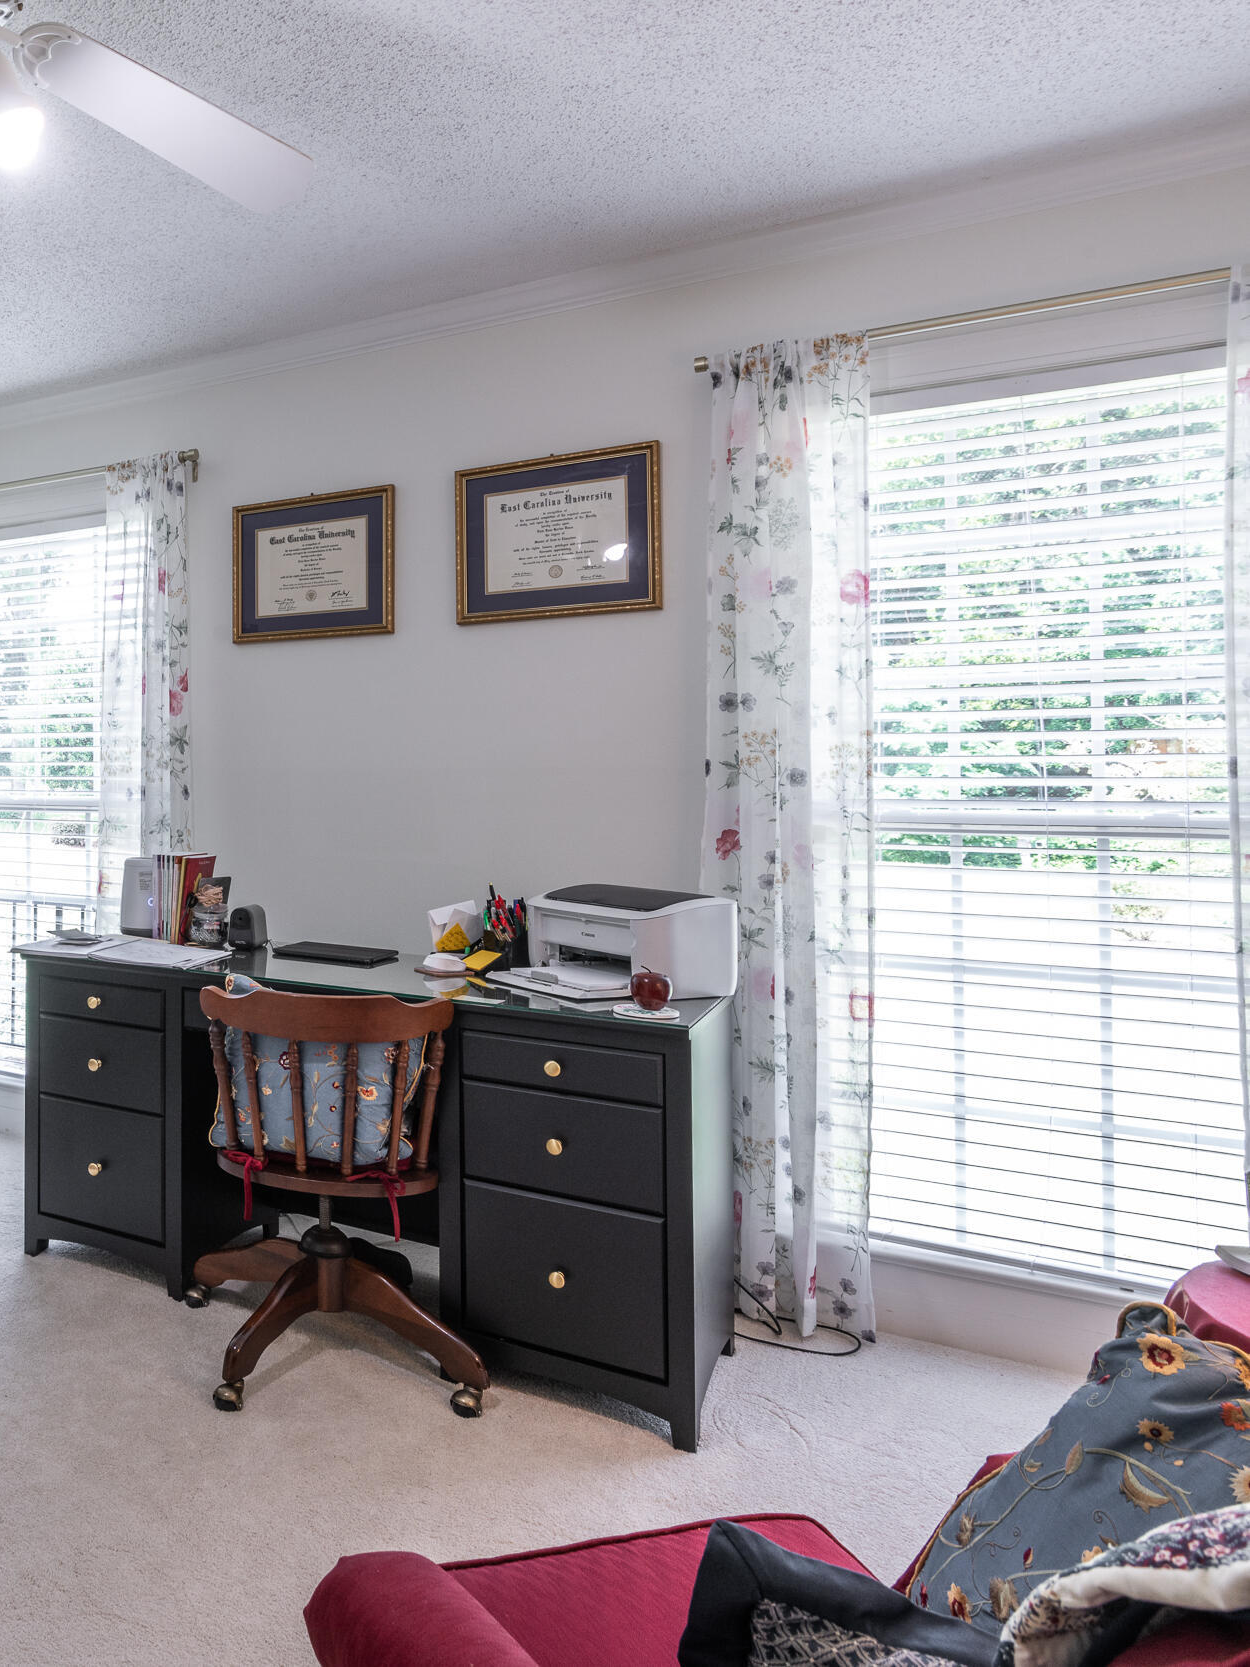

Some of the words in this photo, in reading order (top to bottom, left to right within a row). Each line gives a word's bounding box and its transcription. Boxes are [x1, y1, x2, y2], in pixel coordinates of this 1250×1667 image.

[500, 503, 520, 514] East
[523, 498, 561, 510] Carolina
[564, 491, 612, 504] University
[269, 536, 286, 546] East
[287, 534, 316, 544] Carolina
[317, 528, 355, 541] University
